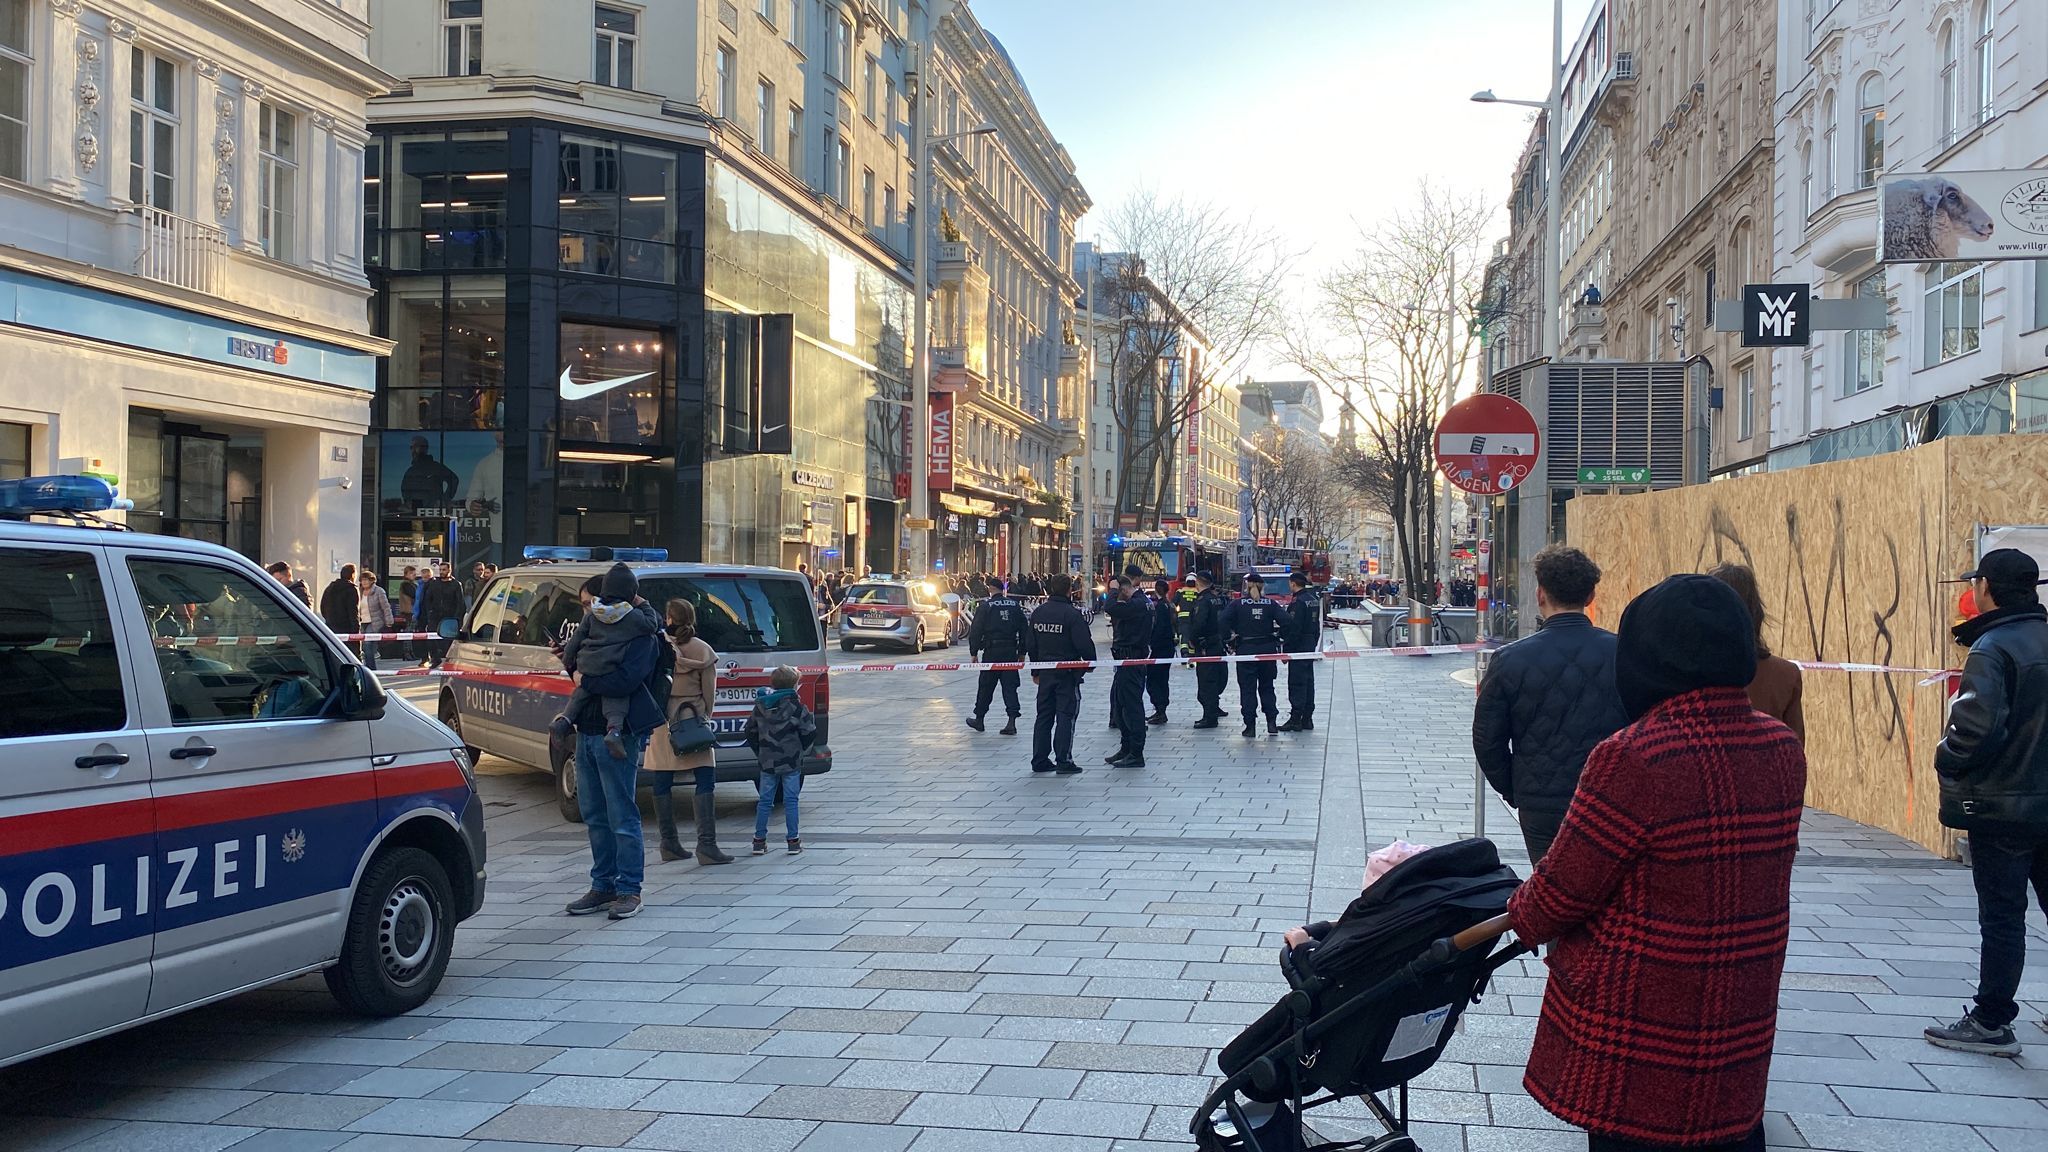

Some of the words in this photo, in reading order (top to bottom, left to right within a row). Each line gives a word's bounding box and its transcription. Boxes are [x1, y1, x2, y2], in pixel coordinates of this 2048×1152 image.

[1998, 242, 2048, 251] www.villgr
[932, 409, 950, 474] HEMA
[466, 686, 505, 716] POLIZEI
[728, 688, 757, 700] 90176
